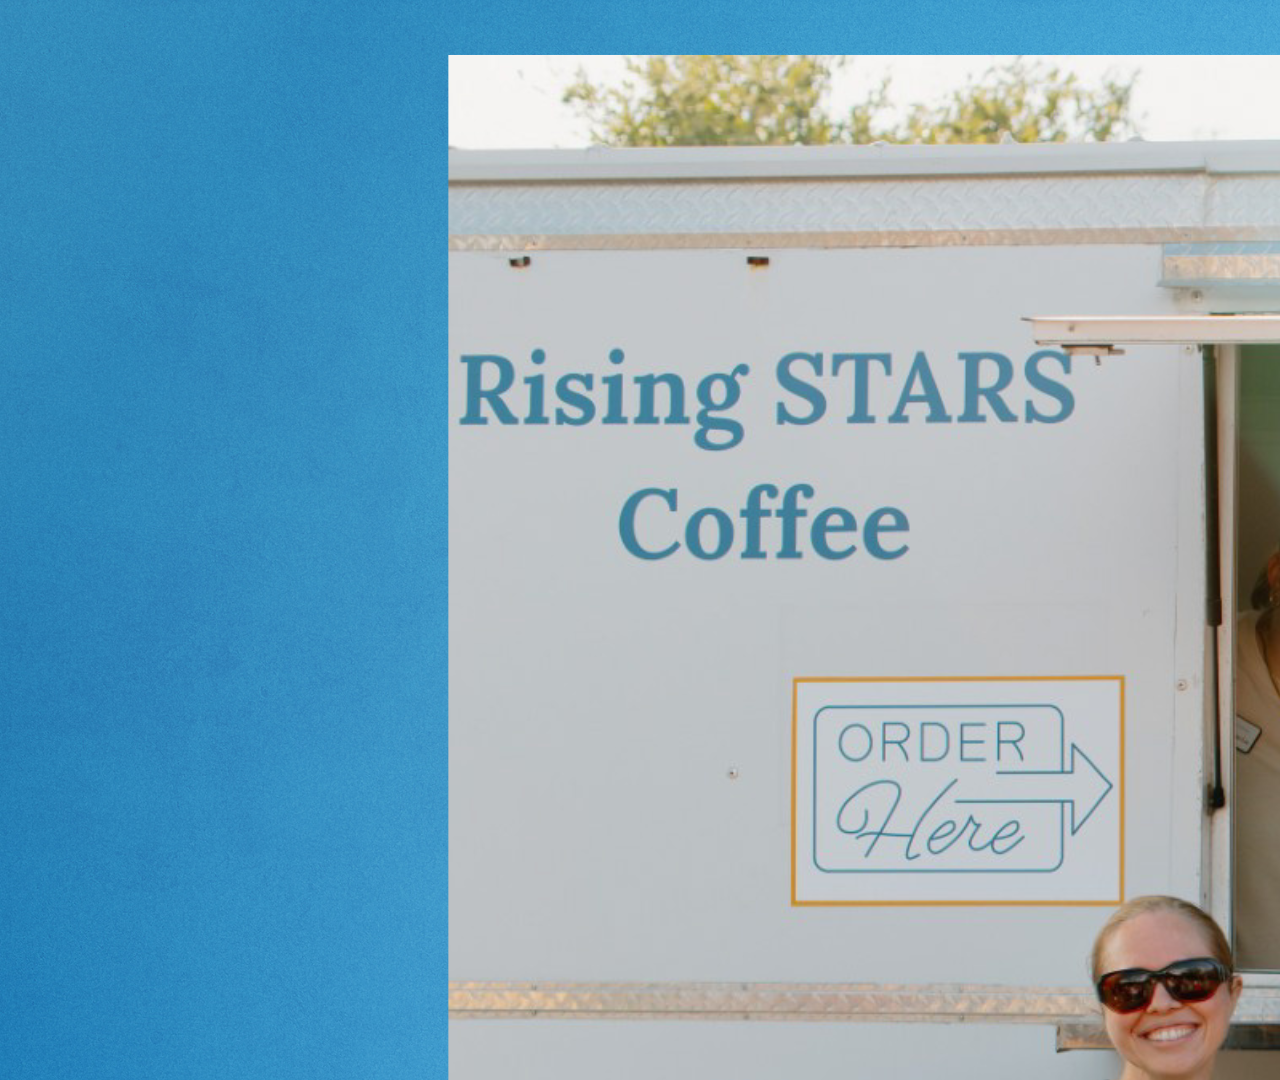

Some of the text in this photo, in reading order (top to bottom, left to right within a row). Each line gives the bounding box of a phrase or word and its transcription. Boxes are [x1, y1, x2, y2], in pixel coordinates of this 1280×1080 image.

[458, 348, 1077, 452] Rising STARS
[618, 483, 911, 561] Coffee
[837, 721, 1026, 763] ORDER
[836, 778, 1026, 860] Here
